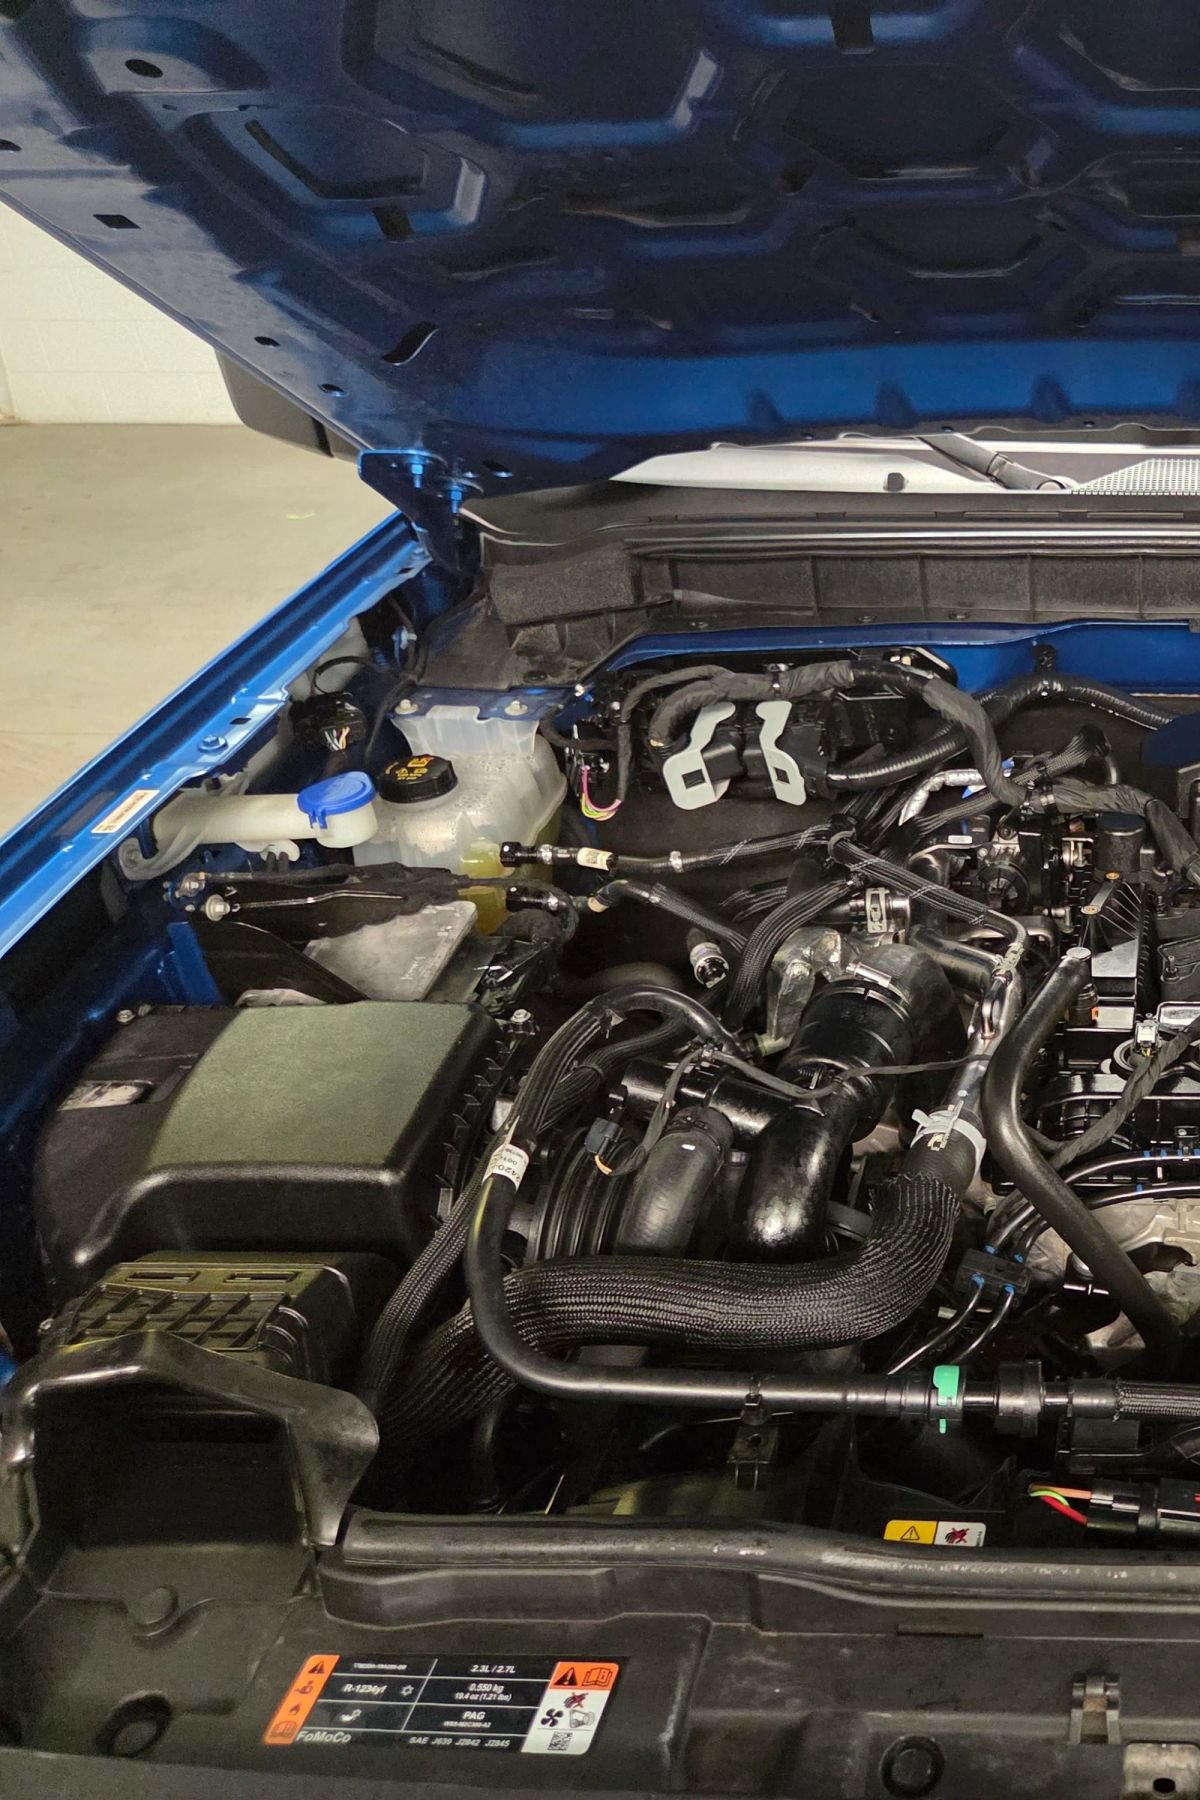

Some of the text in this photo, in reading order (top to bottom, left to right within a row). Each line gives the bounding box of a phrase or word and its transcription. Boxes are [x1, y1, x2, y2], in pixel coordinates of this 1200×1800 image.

[343, 1683, 388, 1696] R-1234yf
[492, 1684, 504, 1694] kg
[463, 1711, 486, 1720] PAG
[296, 1731, 352, 1743] FoMoCo
[409, 1736, 429, 1745] SAE
